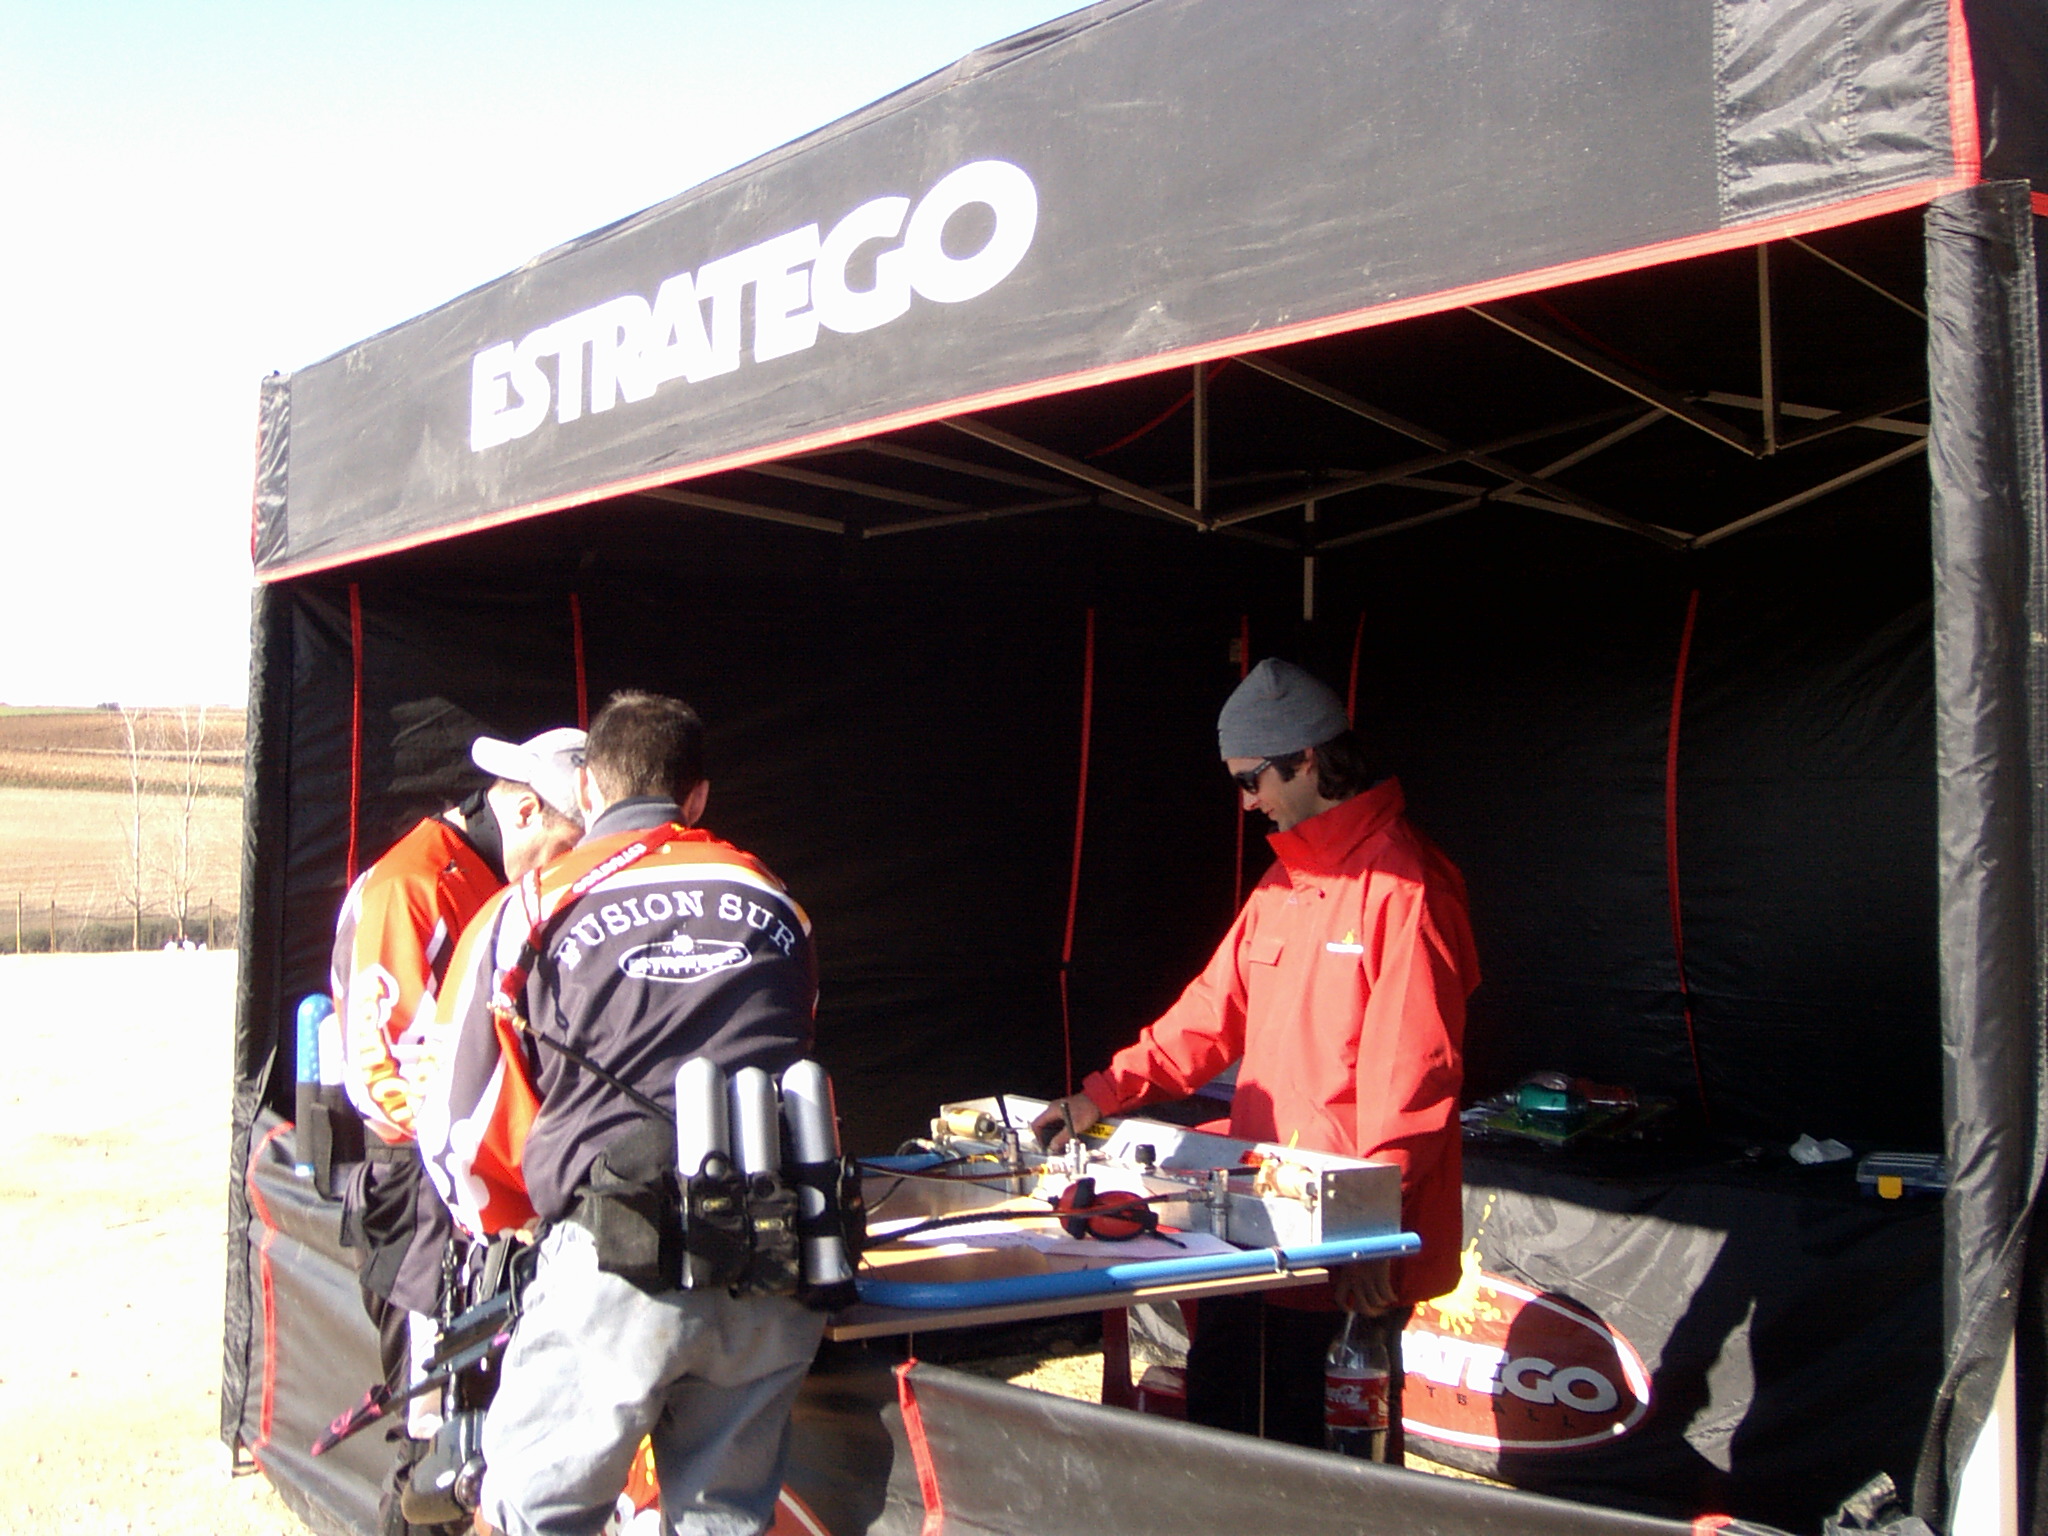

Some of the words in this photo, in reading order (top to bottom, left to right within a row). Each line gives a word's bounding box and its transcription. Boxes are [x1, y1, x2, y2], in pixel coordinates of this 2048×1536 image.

[470, 159, 1038, 452] ESTRATEGO
[554, 890, 704, 970] FUSION
[718, 893, 796, 956] SUR
[1401, 1329, 1619, 1413] ATEGO
